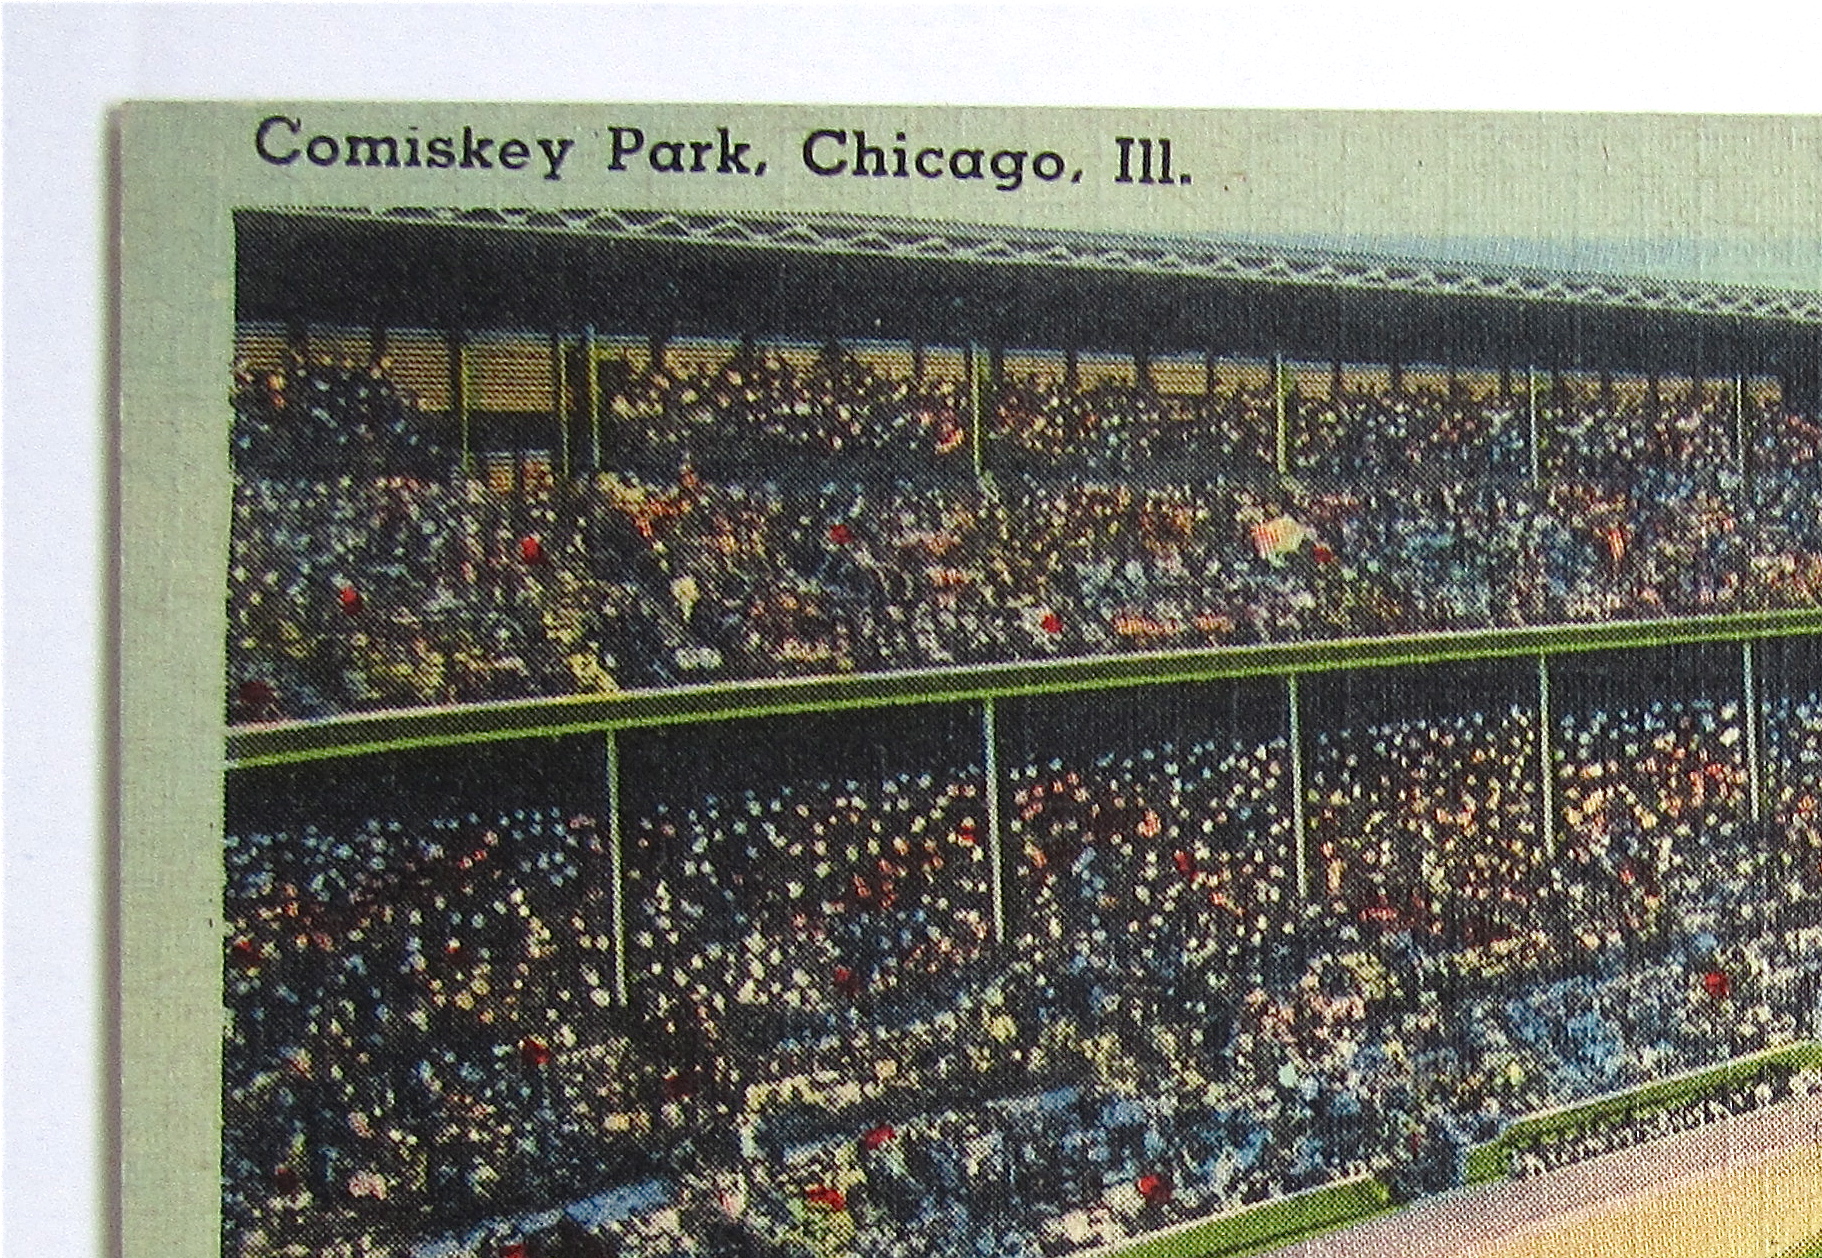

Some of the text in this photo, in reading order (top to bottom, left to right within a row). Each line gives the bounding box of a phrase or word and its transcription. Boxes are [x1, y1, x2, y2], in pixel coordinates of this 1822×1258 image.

[254, 115, 1192, 192] Comiskey Park, Chicago, Ill.
